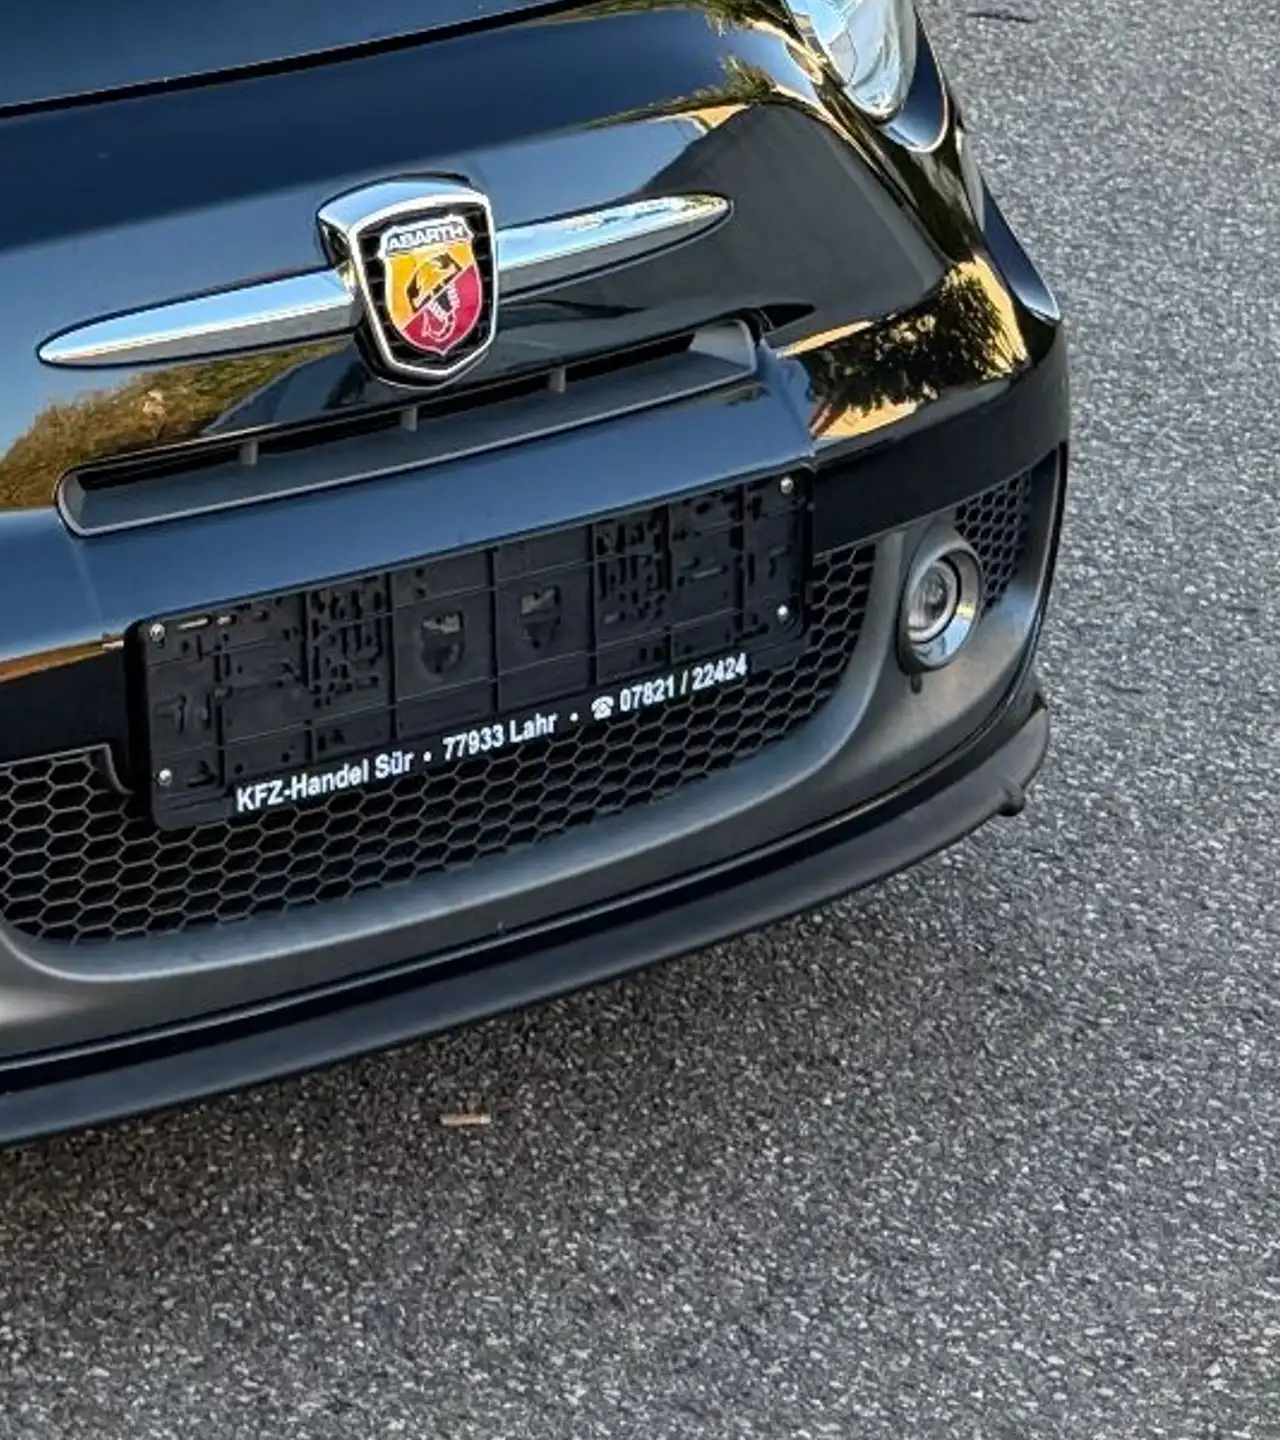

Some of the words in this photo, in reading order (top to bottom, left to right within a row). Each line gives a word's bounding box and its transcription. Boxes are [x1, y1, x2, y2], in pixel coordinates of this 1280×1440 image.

[389, 224, 464, 249] ABARTH
[236, 758, 369, 813] KFZ-Handel
[375, 751, 415, 780] Sür
[442, 724, 505, 761] 77933
[509, 712, 559, 743] Lahr
[619, 674, 675, 712] 07821
[680, 669, 689, 696] /
[691, 652, 748, 691] 22424
